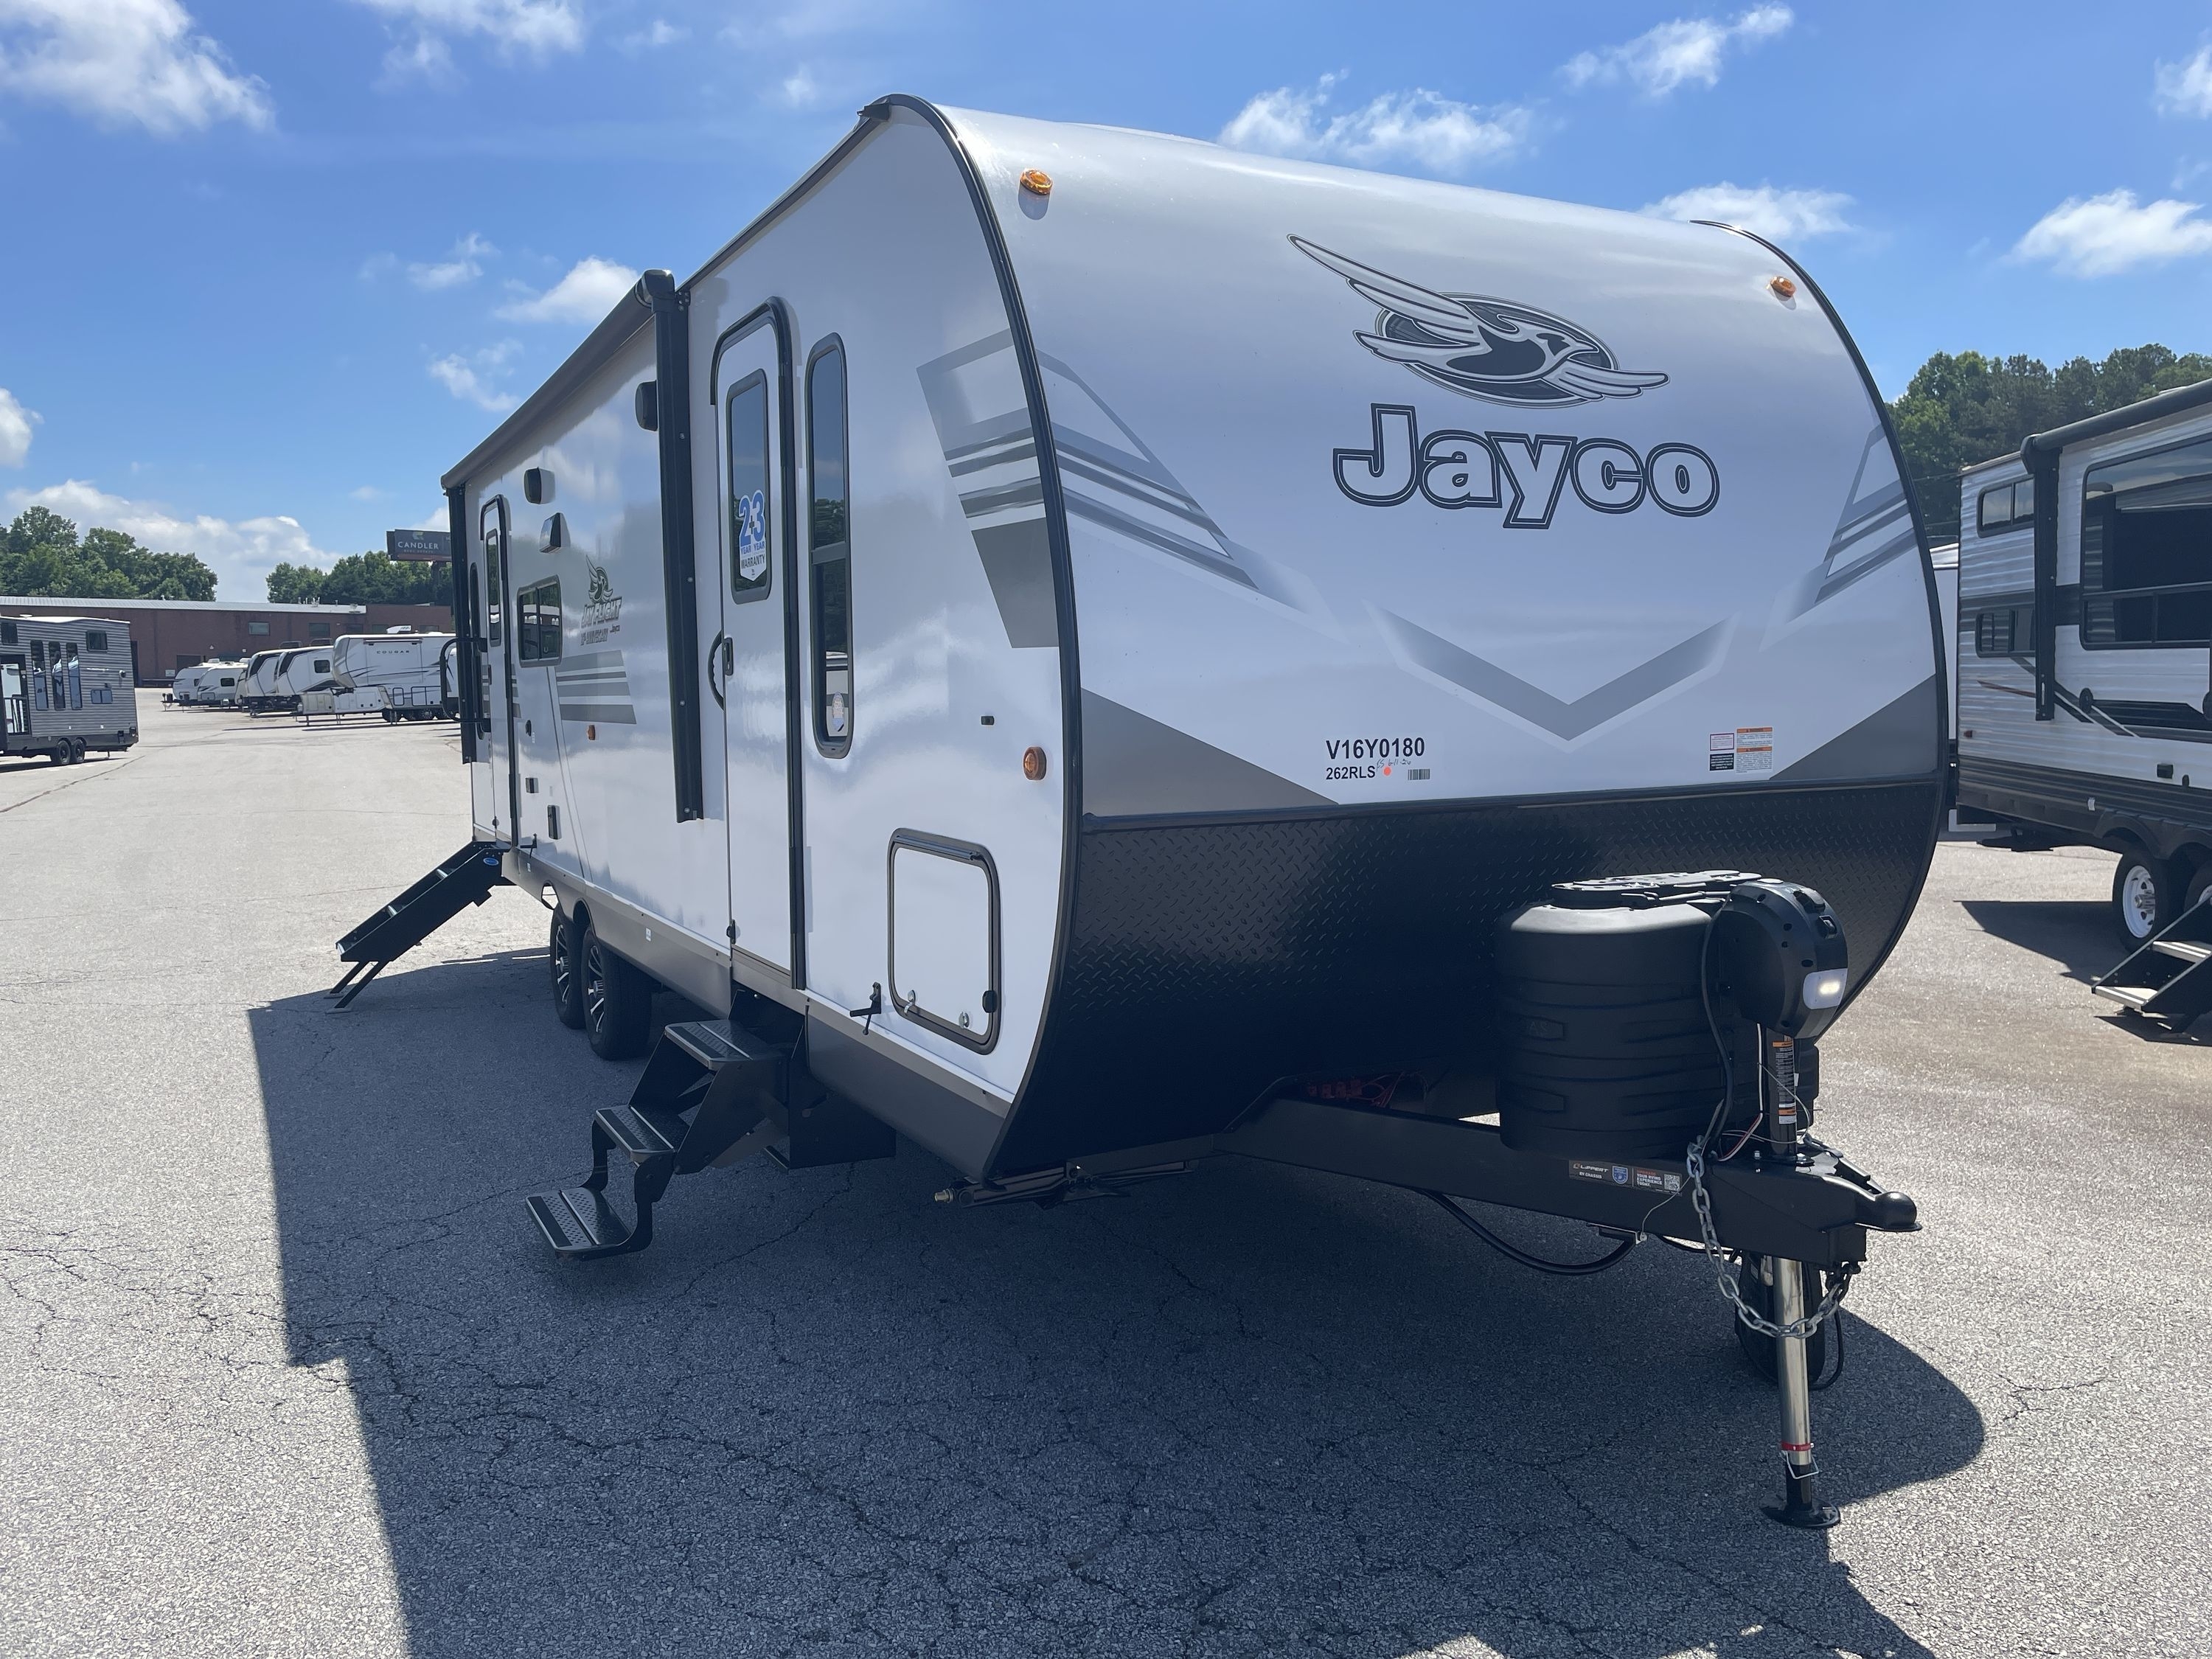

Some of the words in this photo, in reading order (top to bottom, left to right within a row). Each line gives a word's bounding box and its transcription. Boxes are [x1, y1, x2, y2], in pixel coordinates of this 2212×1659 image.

[1332, 403, 1720, 529] Jayco
[397, 541, 439, 549] CANDLER
[740, 545, 751, 554] YEAR
[754, 541, 765, 551] YEAR
[741, 554, 765, 569] WARRANTY
[581, 604, 595, 628] JAY
[593, 597, 622, 625] FLIGHT
[1326, 737, 1425, 759] V16Y0180
[1326, 765, 1376, 780] 262RLS
[1636, 1177, 1663, 1185] EXPERIENCE
